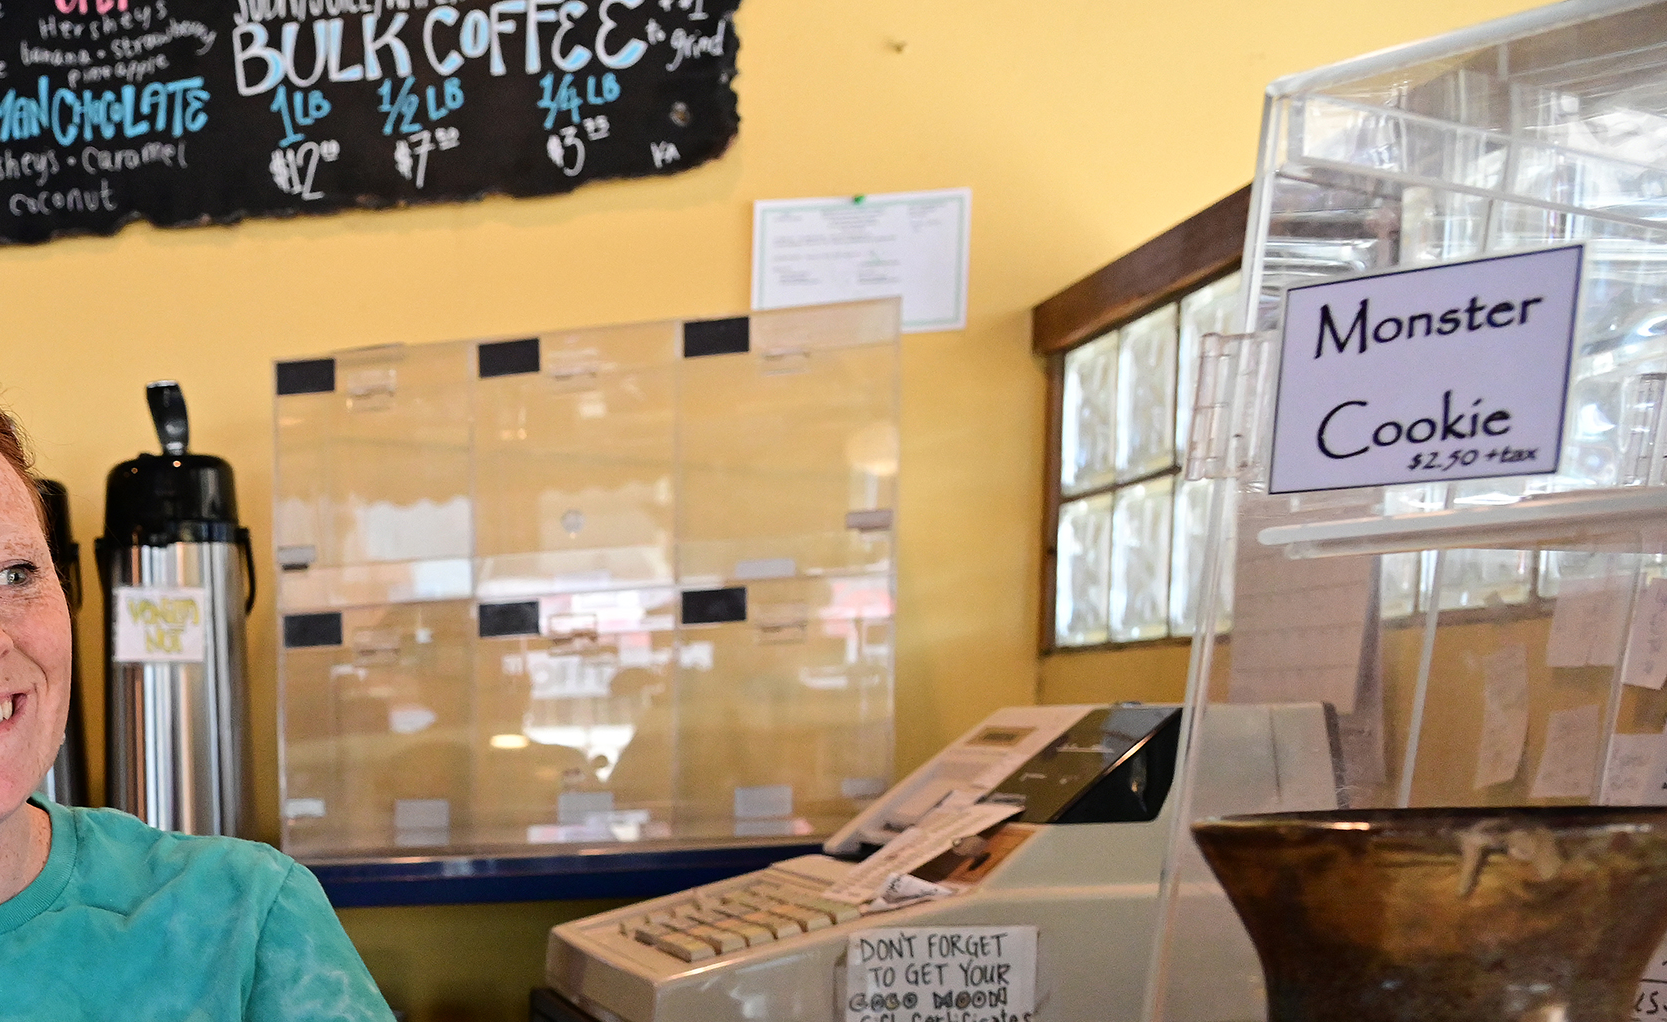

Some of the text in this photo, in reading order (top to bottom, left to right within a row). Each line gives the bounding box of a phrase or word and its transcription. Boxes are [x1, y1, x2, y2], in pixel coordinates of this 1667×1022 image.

[232, 0, 648, 97] BULK COFFEE
[426, 77, 465, 121] LB
[586, 71, 621, 105] LB
[270, 83, 306, 148] 1
[1314, 294, 1546, 360] Monster
[1316, 389, 1511, 460] Cookie
[1407, 448, 1480, 472] $2.50
[859, 930, 1008, 963] DON'T FORGET
[868, 959, 1011, 988] TO GET YOUR
[932, 986, 1008, 1011] MOON
